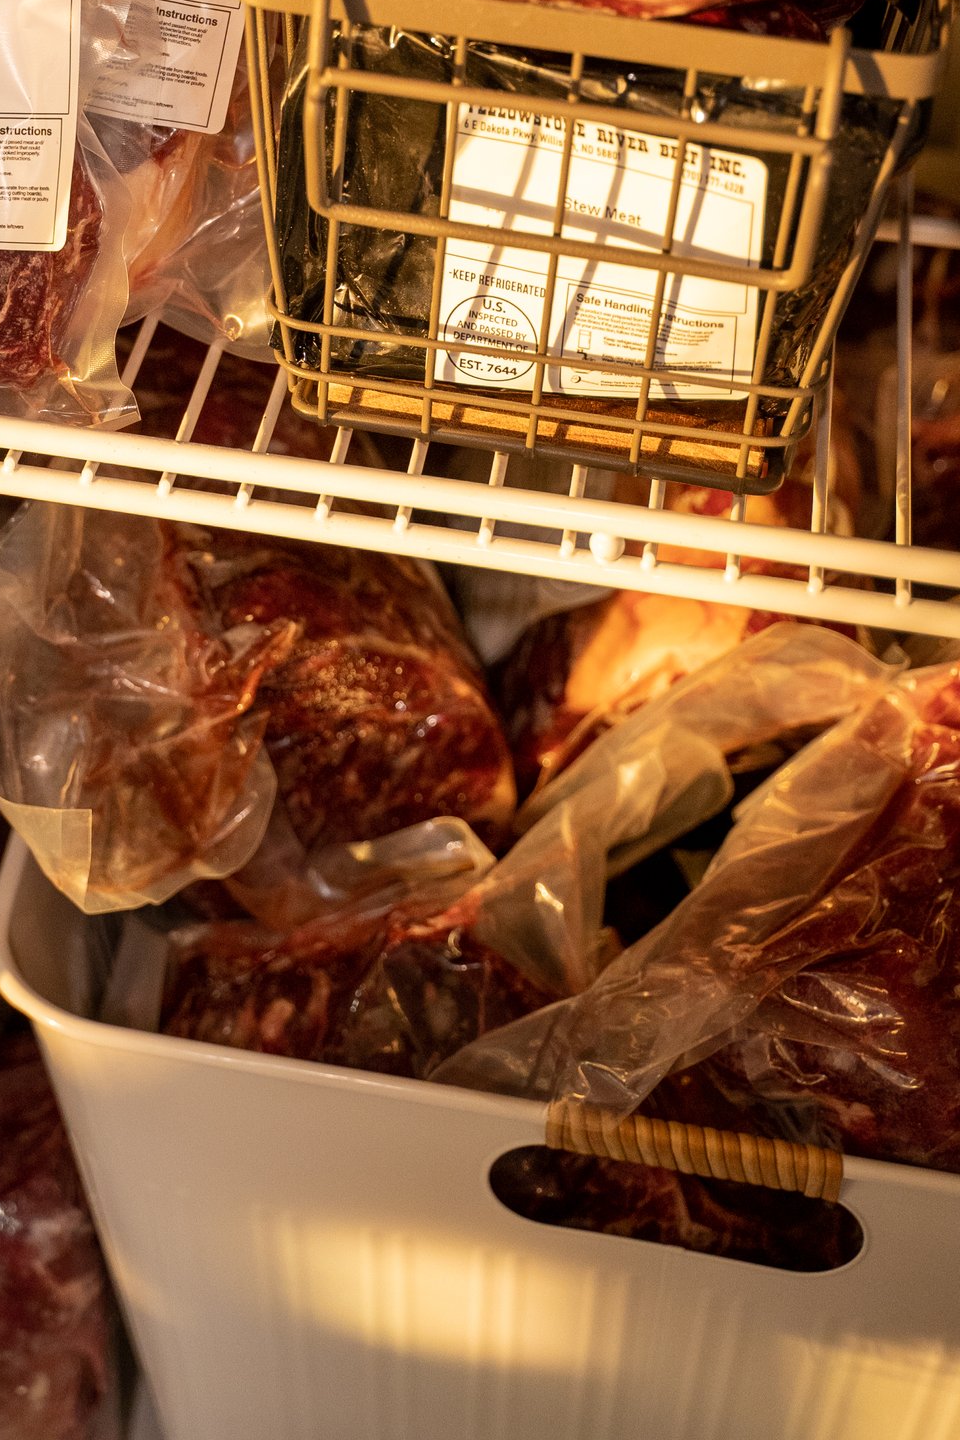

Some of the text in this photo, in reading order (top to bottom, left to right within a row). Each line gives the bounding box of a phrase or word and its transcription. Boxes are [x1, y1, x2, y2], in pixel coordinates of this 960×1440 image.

[156, 6, 219, 27] Instructions
[464, 118, 470, 129] 6
[472, 120, 477, 130] E
[480, 121, 510, 136] Dakota
[512, 127, 537, 143] Pkwy.
[581, 145, 594, 155] ND
[468, 106, 747, 179] ELLOWSTOE RIVER BEF INC.
[564, 197, 642, 227] Stew Meat
[483, 298, 507, 314] U.S.
[576, 292, 602, 306] Safe
[604, 298, 654, 317] Handling
[659, 311, 725, 329] nstructions
[468, 310, 518, 328] INSPECTED
[453, 330, 529, 353] DEPARTMENT OF
[457, 320, 528, 341] AND PASSED BY
[459, 358, 484, 372] EST.
[487, 363, 518, 376] 7644
